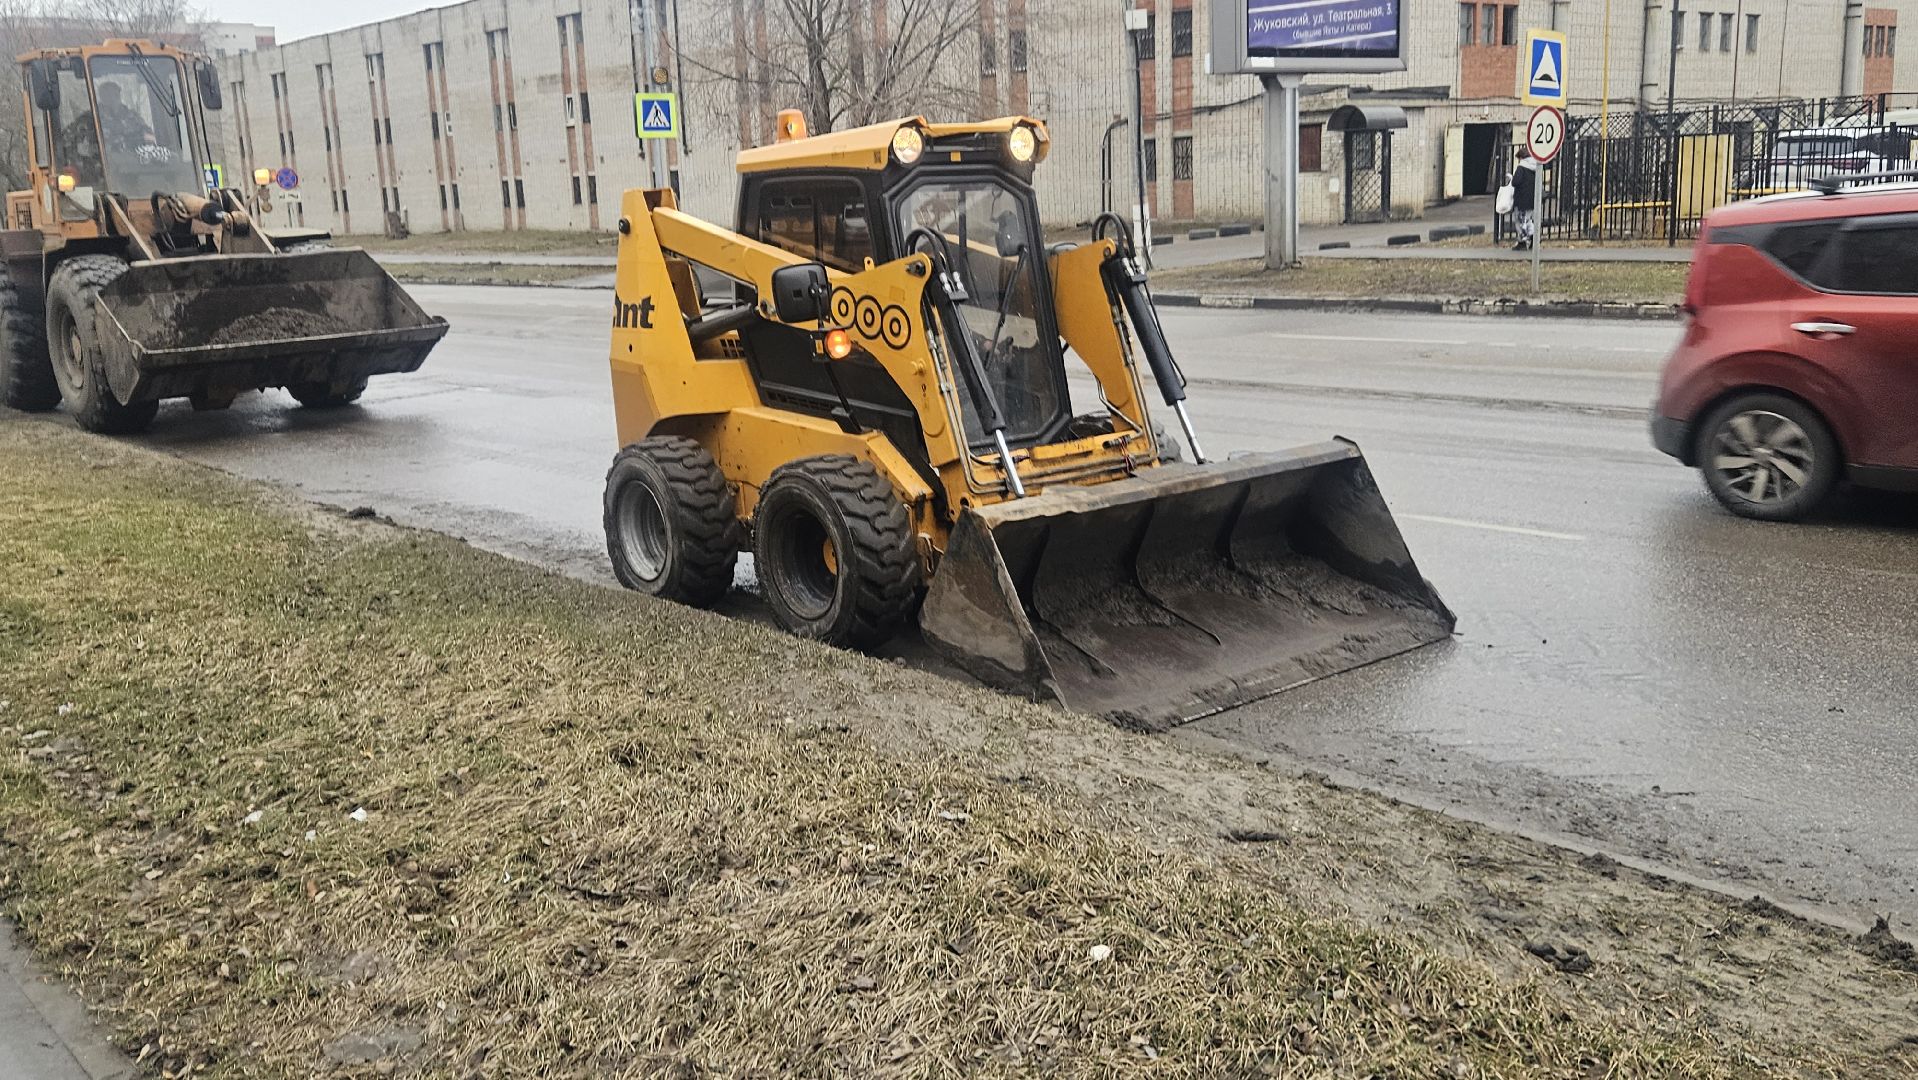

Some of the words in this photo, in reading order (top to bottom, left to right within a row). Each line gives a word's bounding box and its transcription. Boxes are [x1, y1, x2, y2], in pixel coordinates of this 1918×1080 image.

[1313, 14, 1325, 27] ул.
[1341, 25, 1345, 34] и
[1346, 21, 1372, 32] Катера)
[1535, 123, 1554, 144] 20
